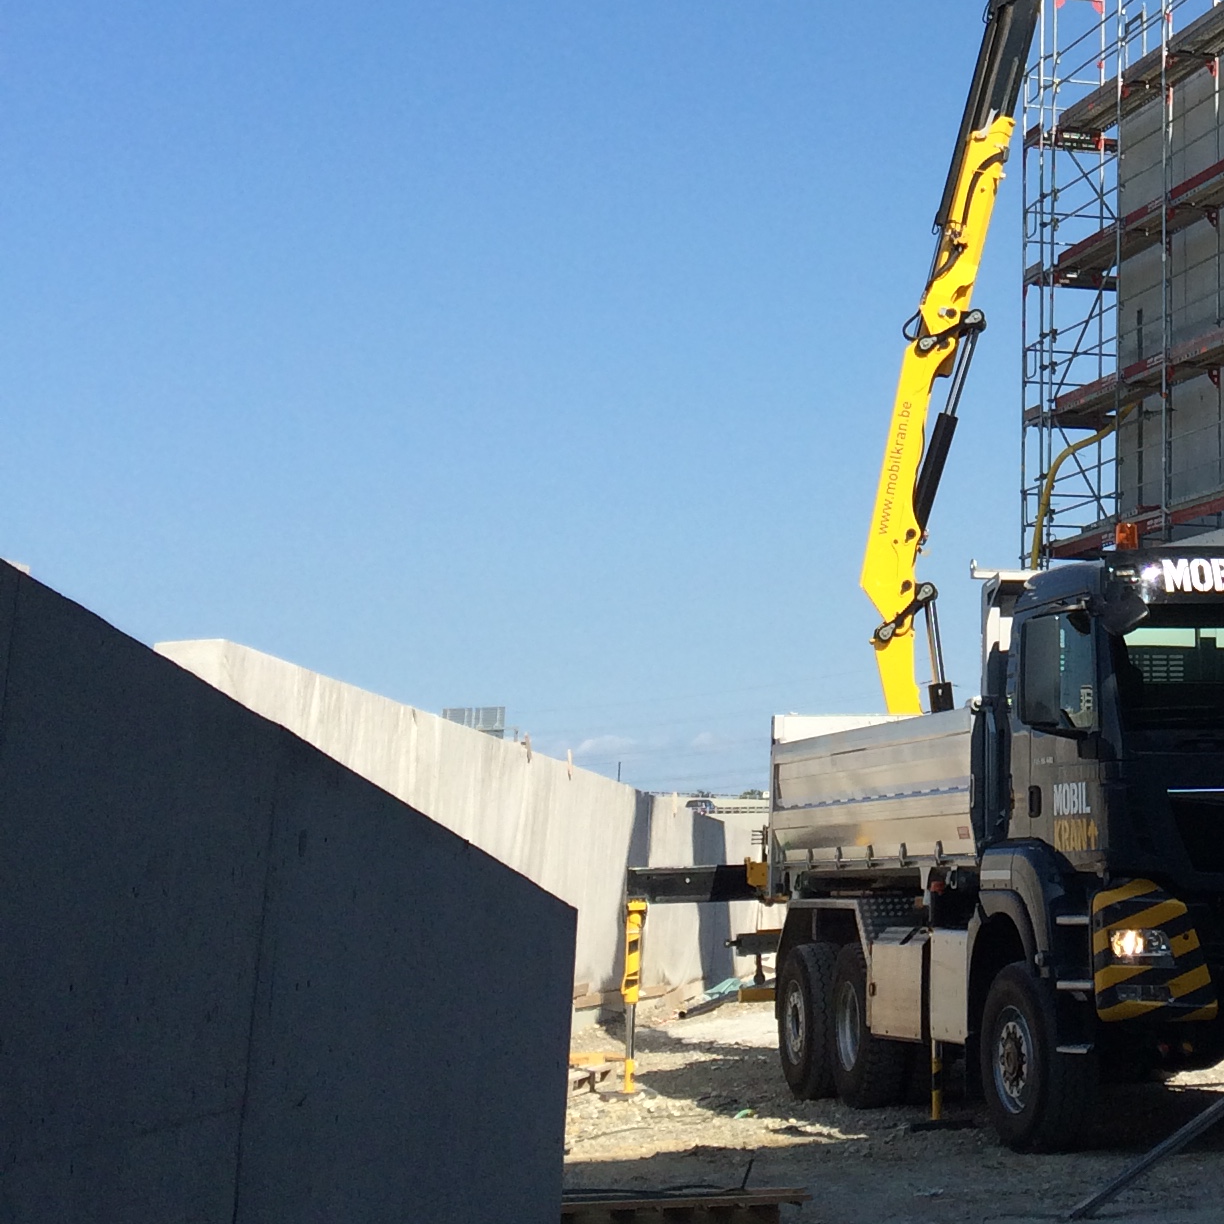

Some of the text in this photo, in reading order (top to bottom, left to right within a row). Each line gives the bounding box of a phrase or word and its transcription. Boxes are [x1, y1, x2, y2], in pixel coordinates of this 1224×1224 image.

[878, 401, 912, 535] www.mobilkran.be
[1053, 781, 1091, 816] MOBIL
[1053, 817, 1088, 852] KRAN
